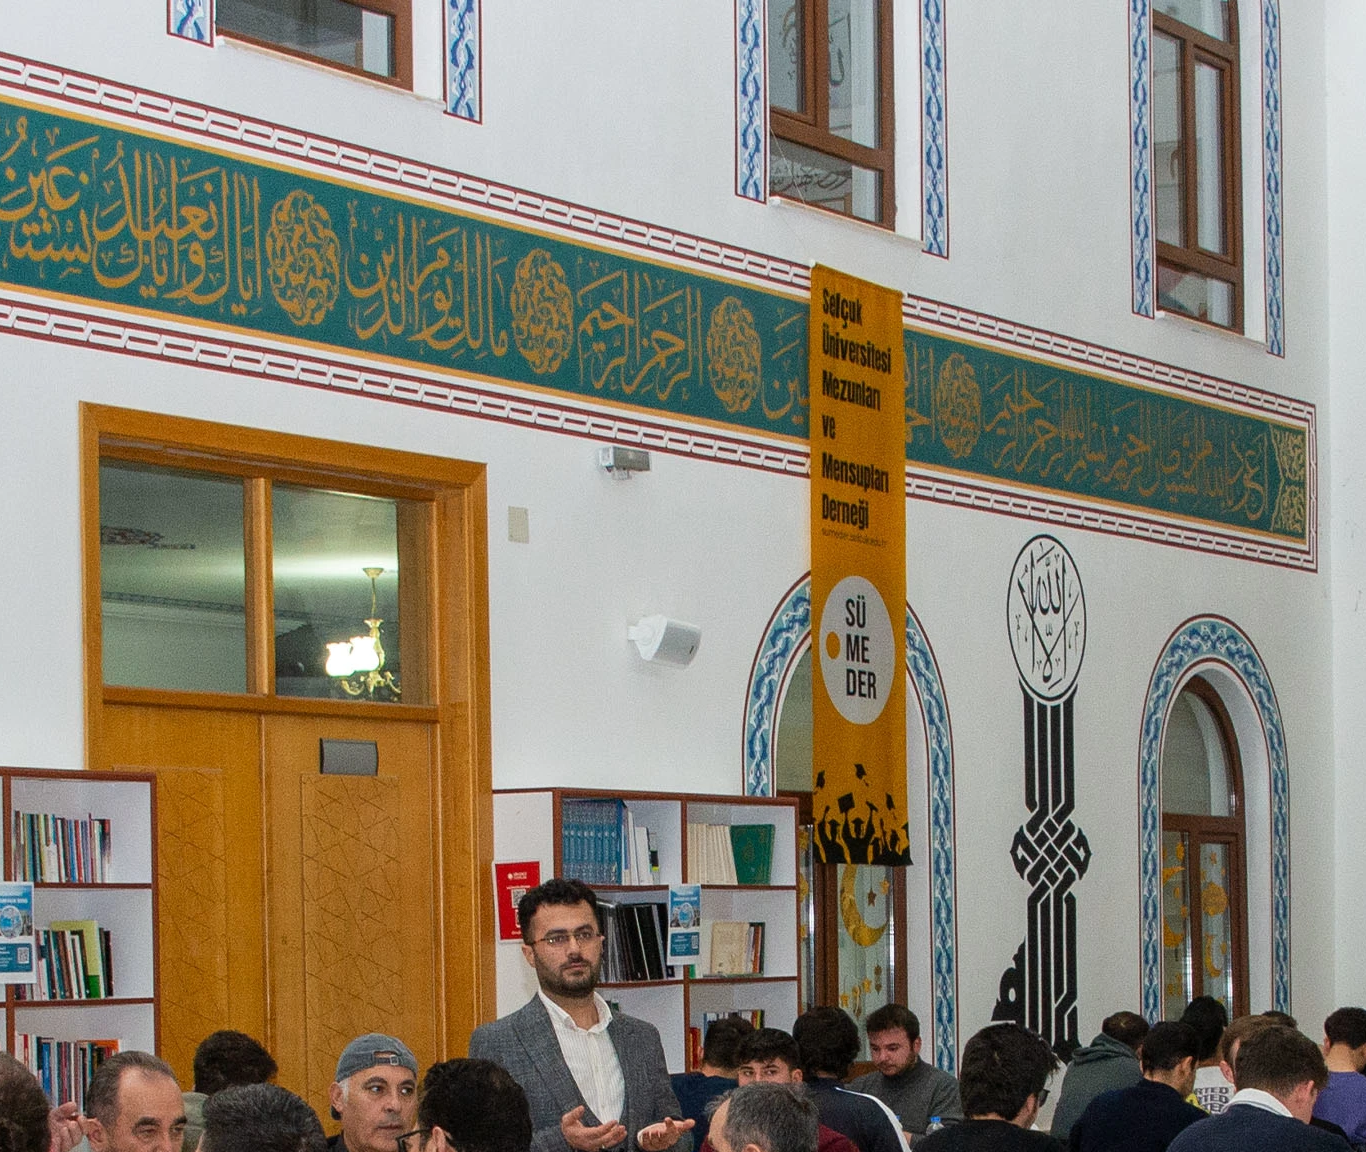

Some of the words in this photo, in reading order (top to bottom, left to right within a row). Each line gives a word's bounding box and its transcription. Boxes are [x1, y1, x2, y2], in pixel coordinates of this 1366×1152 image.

[822, 287, 863, 329] Selçuk
[822, 322, 892, 375] Üniversitesi
[822, 369, 881, 412] Mezunları
[821, 414, 836, 440] ve
[822, 451, 889, 494] Mensupları
[822, 493, 870, 531] Derneği
[845, 595, 866, 629] SÜ
[845, 633, 870, 664] ME
[845, 668, 877, 700] DER
